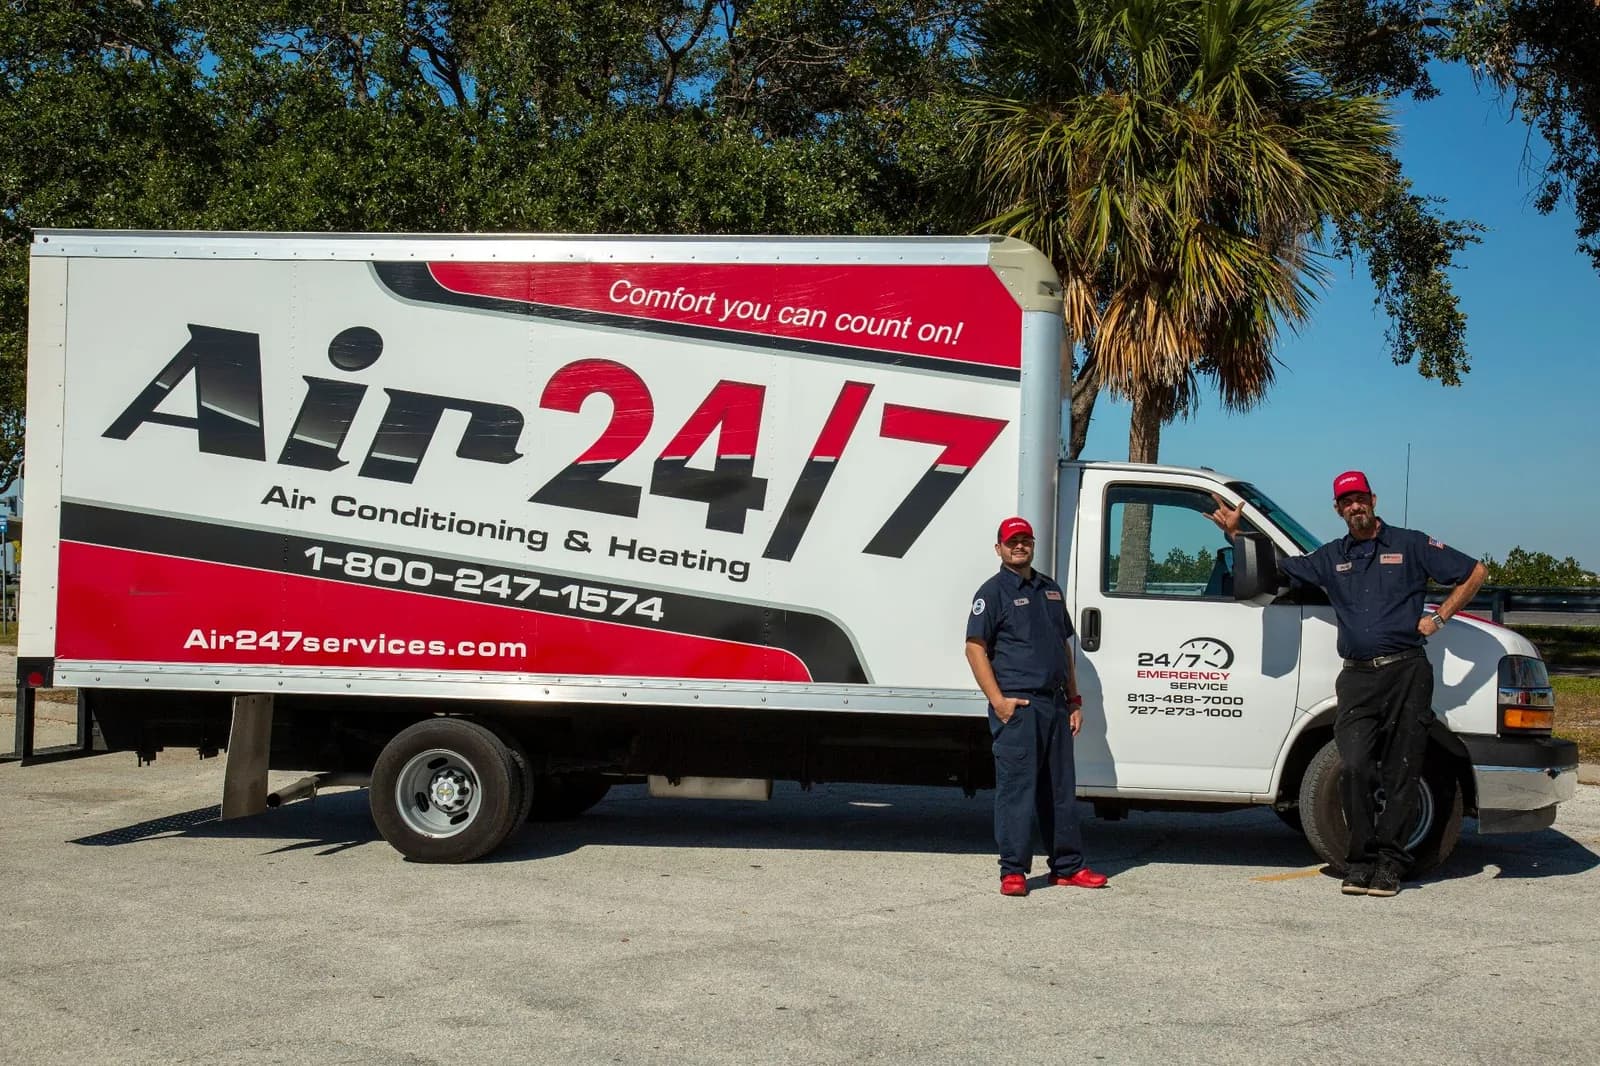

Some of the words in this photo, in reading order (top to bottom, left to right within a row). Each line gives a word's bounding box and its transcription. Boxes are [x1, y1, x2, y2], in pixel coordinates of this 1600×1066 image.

[608, 279, 716, 315] Comfort
[719, 298, 771, 322] you
[777, 304, 827, 329] can
[834, 311, 912, 339] count
[917, 321, 964, 346] on!
[260, 485, 316, 511] Air
[330, 495, 548, 552] Conditioning
[563, 529, 591, 554] &
[608, 535, 751, 582] Heating
[303, 546, 665, 622] 1-800-247-1574
[183, 628, 528, 658] Air247services.com
[1137, 652, 1201, 668] 24/7
[1137, 670, 1230, 680] EMERGENCY
[1169, 682, 1228, 691] SERVICE
[1127, 693, 1243, 705] 813-488-7000
[1128, 706, 1242, 717] 727-273-1000
